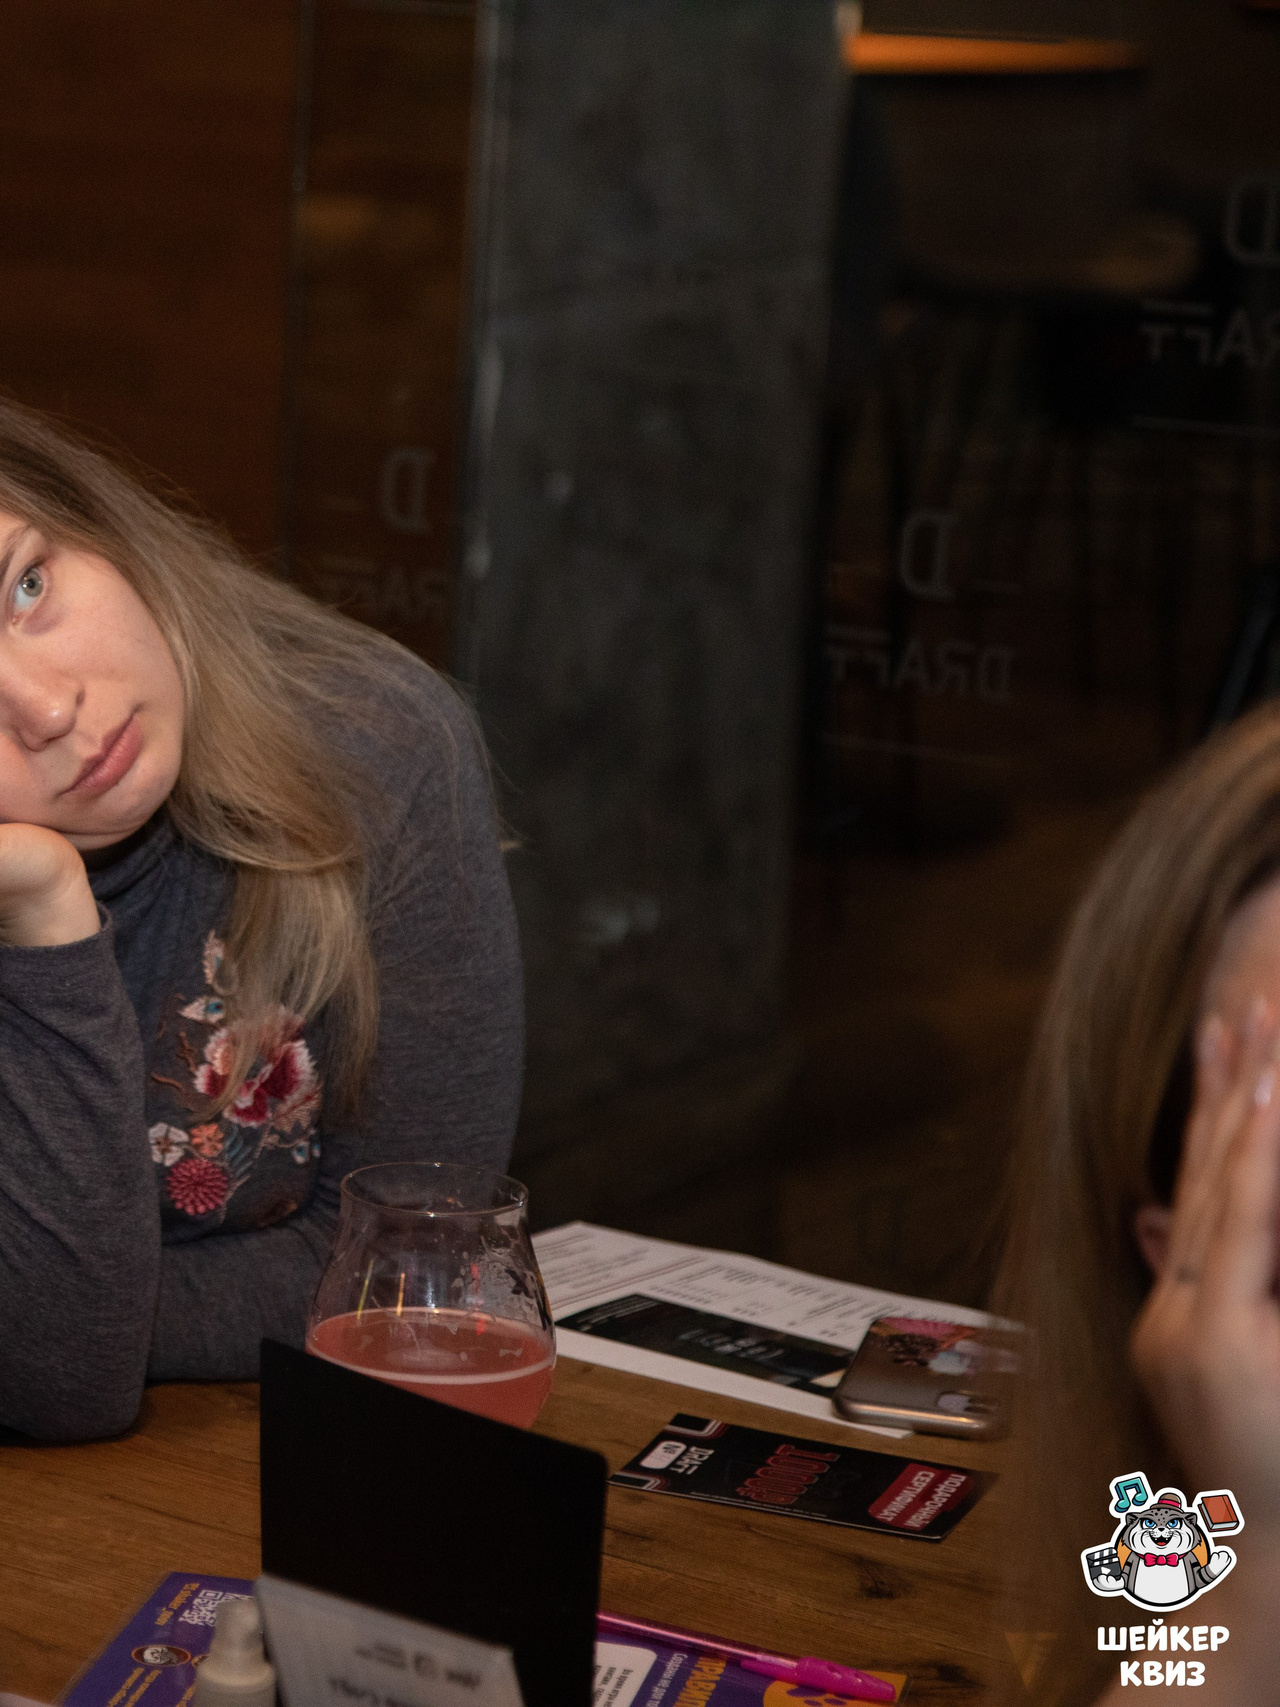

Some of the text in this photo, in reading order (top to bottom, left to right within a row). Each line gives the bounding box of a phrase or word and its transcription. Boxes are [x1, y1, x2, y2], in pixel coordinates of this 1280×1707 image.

[669, 1446, 714, 1475] DRAFT
[878, 1470, 936, 1522] СЕРТИФИКАТ
[902, 1473, 967, 1529] ПОДАРОЧНЫЙ
